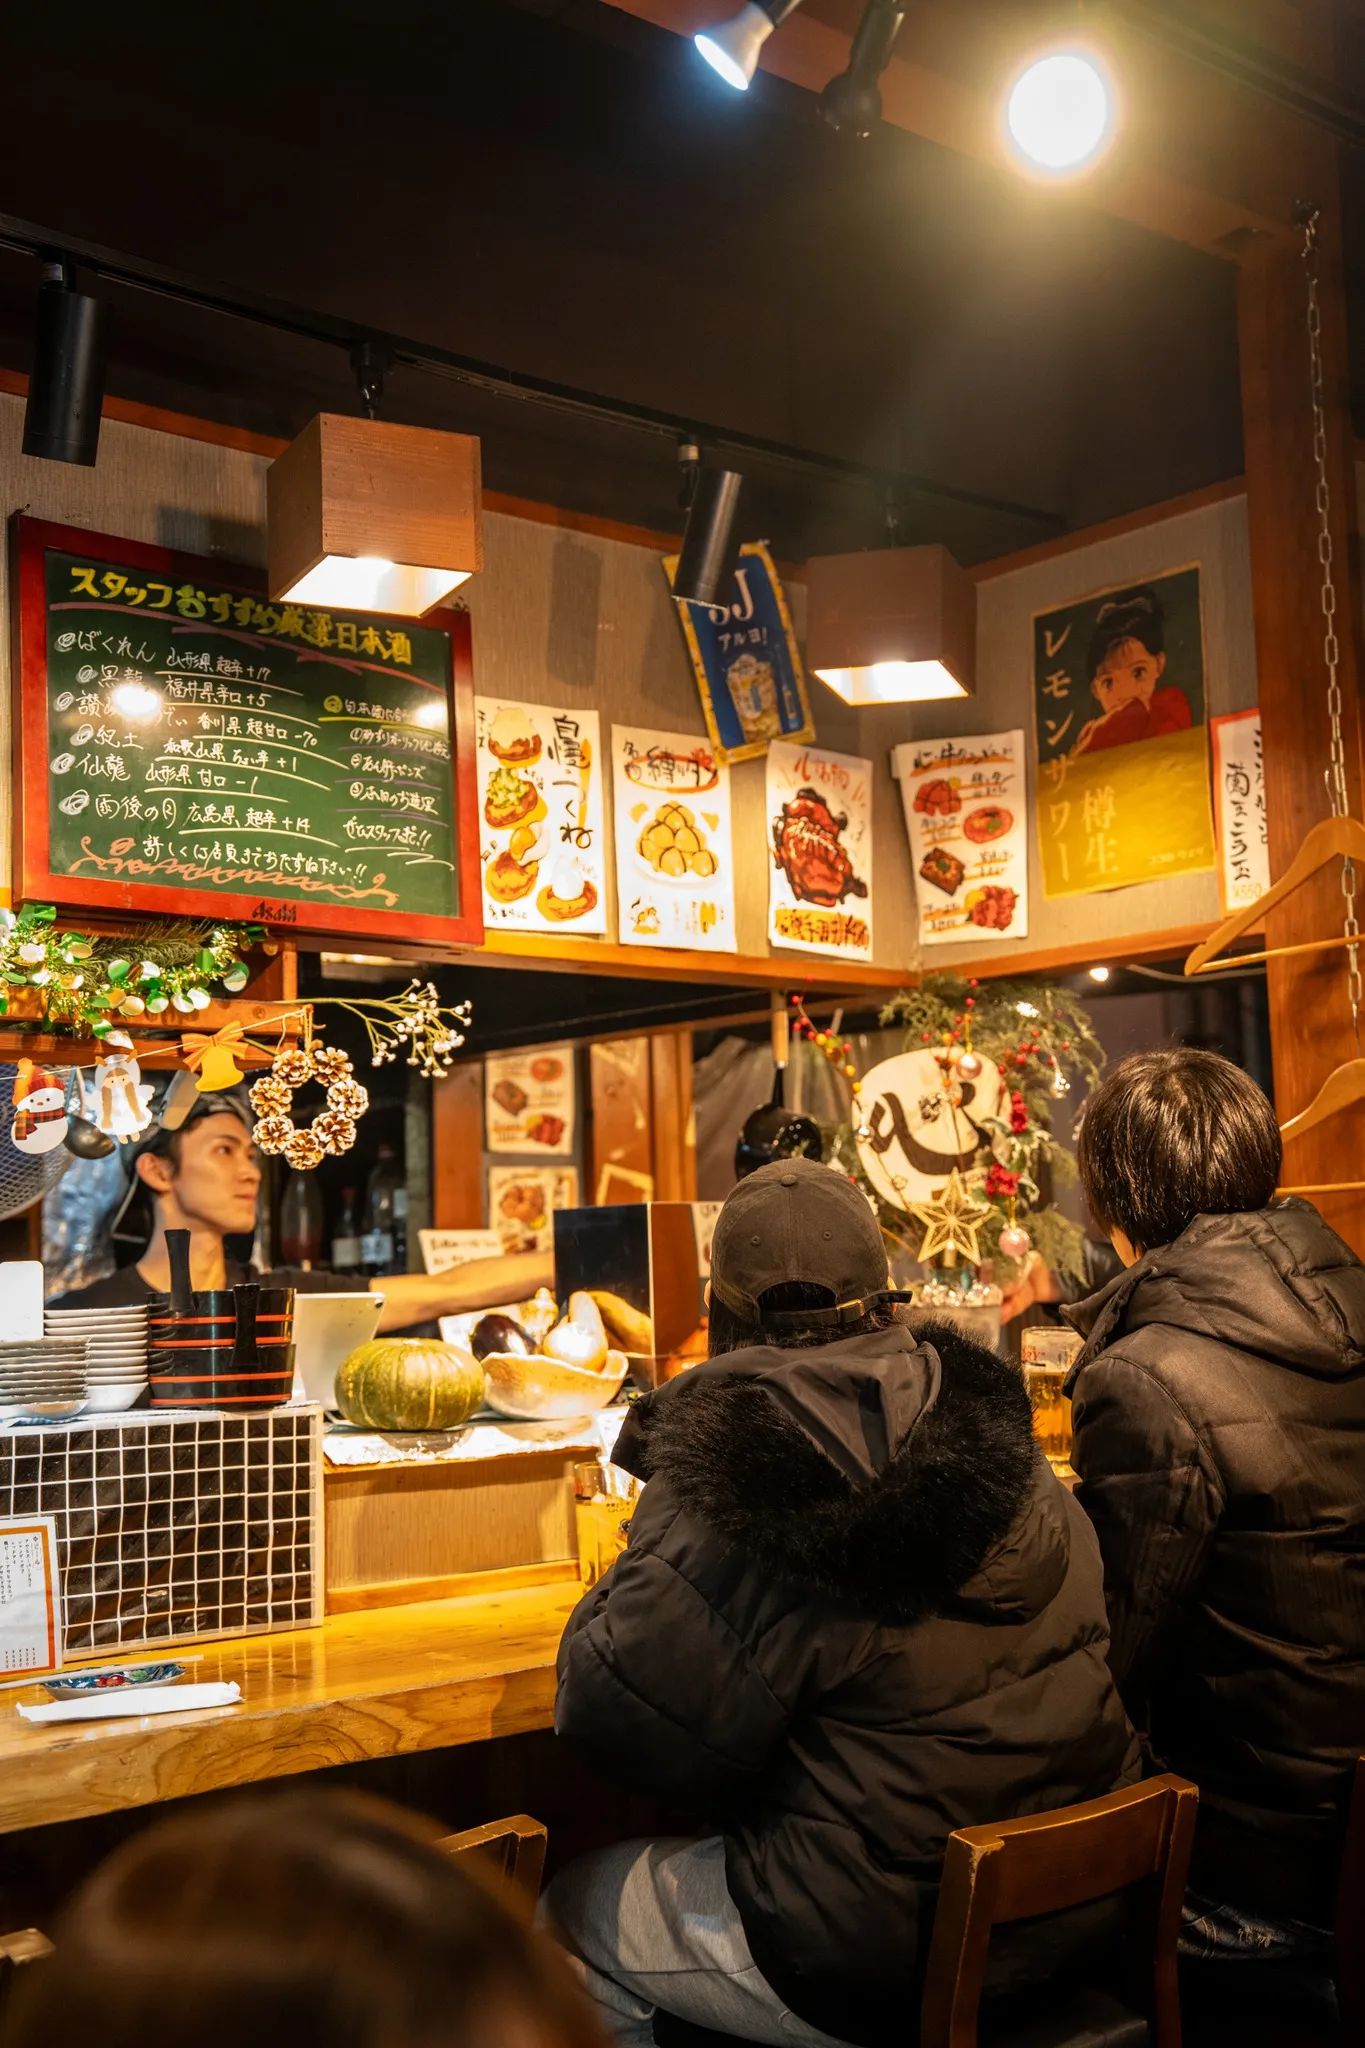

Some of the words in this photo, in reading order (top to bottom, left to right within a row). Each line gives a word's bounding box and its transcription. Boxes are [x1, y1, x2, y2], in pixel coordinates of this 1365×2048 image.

[166, 647, 213, 673] 山形県
[198, 711, 241, 742] 香川県
[1041, 623, 1075, 882] レモンサワー
[145, 763, 193, 786] 山形県
[197, 768, 226, 788] 甘口
[95, 793, 177, 829] 雨後の月
[182, 801, 241, 828] 広島県
[252, 901, 297, 923] Asahi
